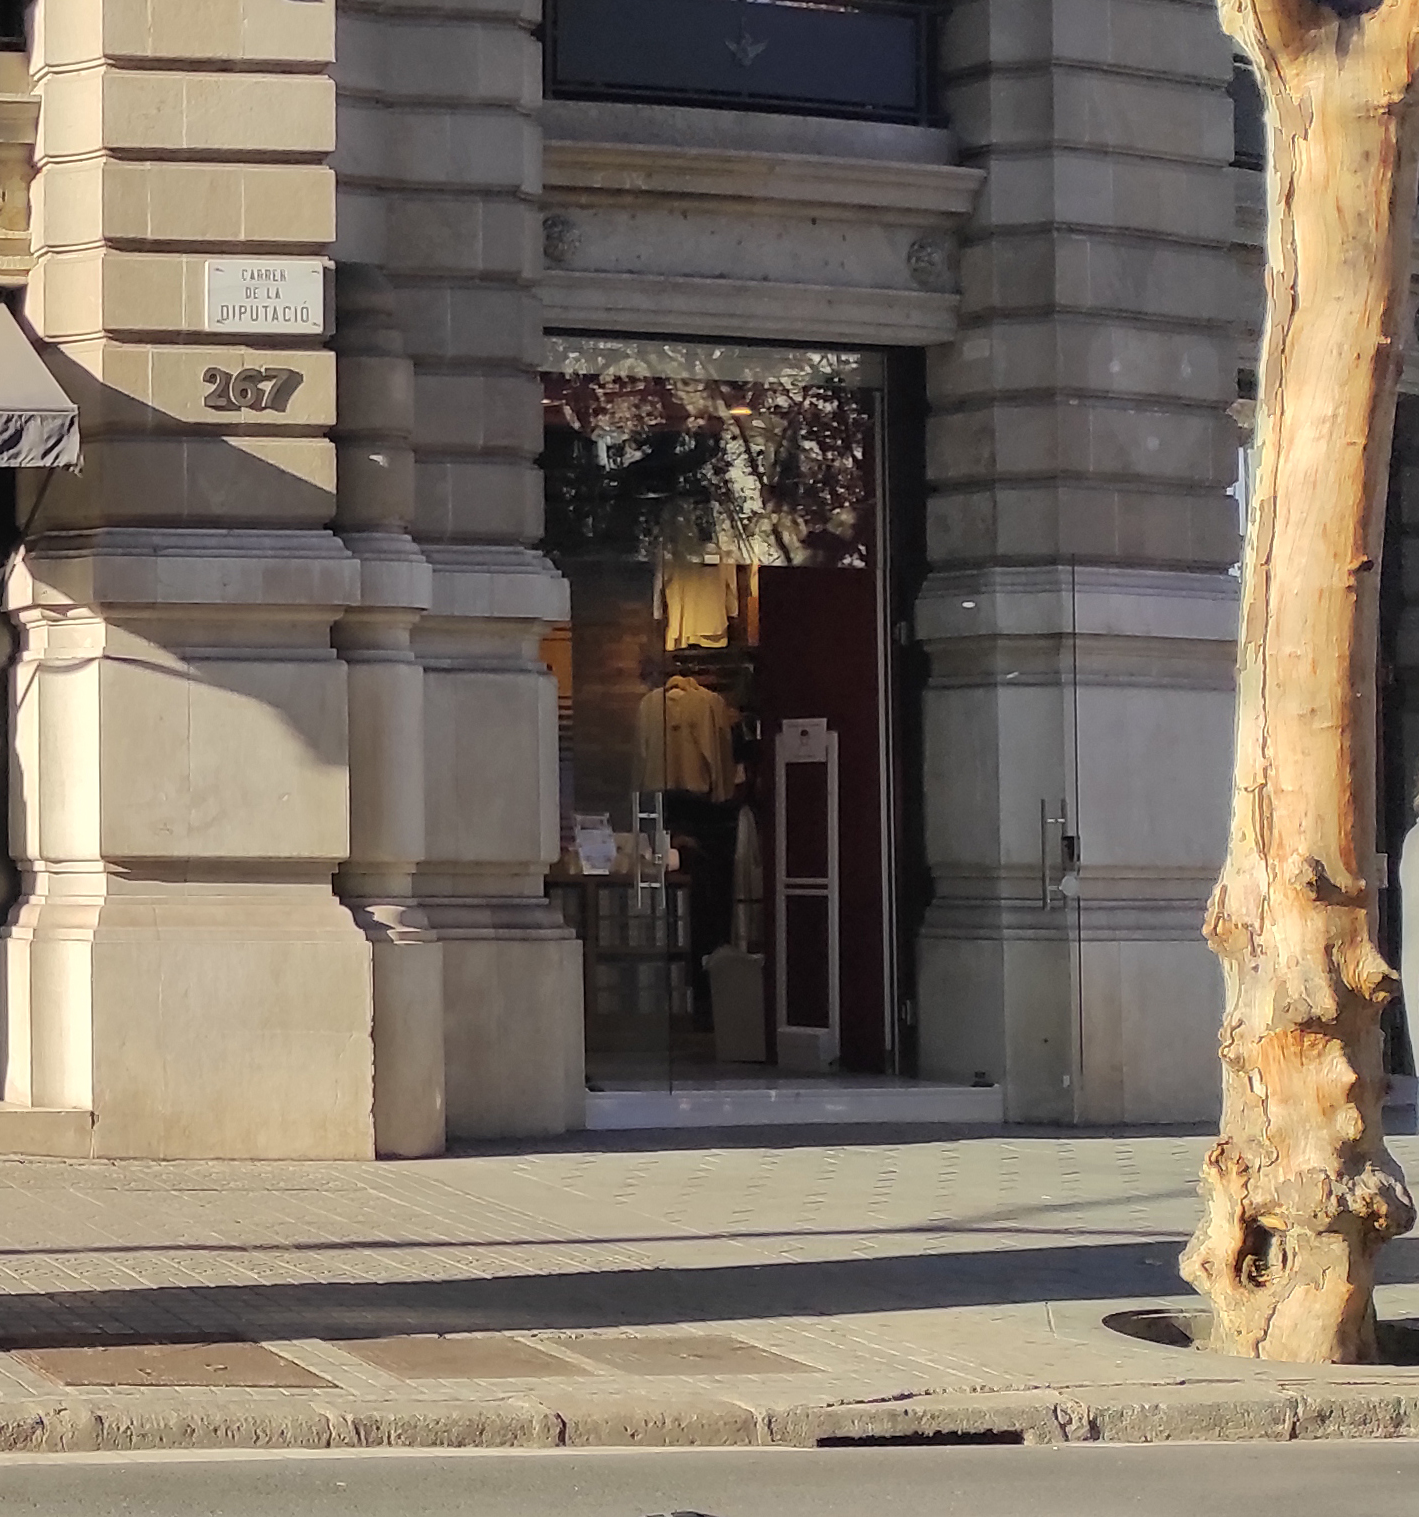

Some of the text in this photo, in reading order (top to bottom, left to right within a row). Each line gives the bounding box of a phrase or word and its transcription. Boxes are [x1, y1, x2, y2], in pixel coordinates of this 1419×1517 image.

[241, 268, 287, 282] CARRER
[245, 287, 281, 299] DE LA
[219, 300, 310, 323] DIPUTACIÓ
[202, 366, 303, 412] 267
